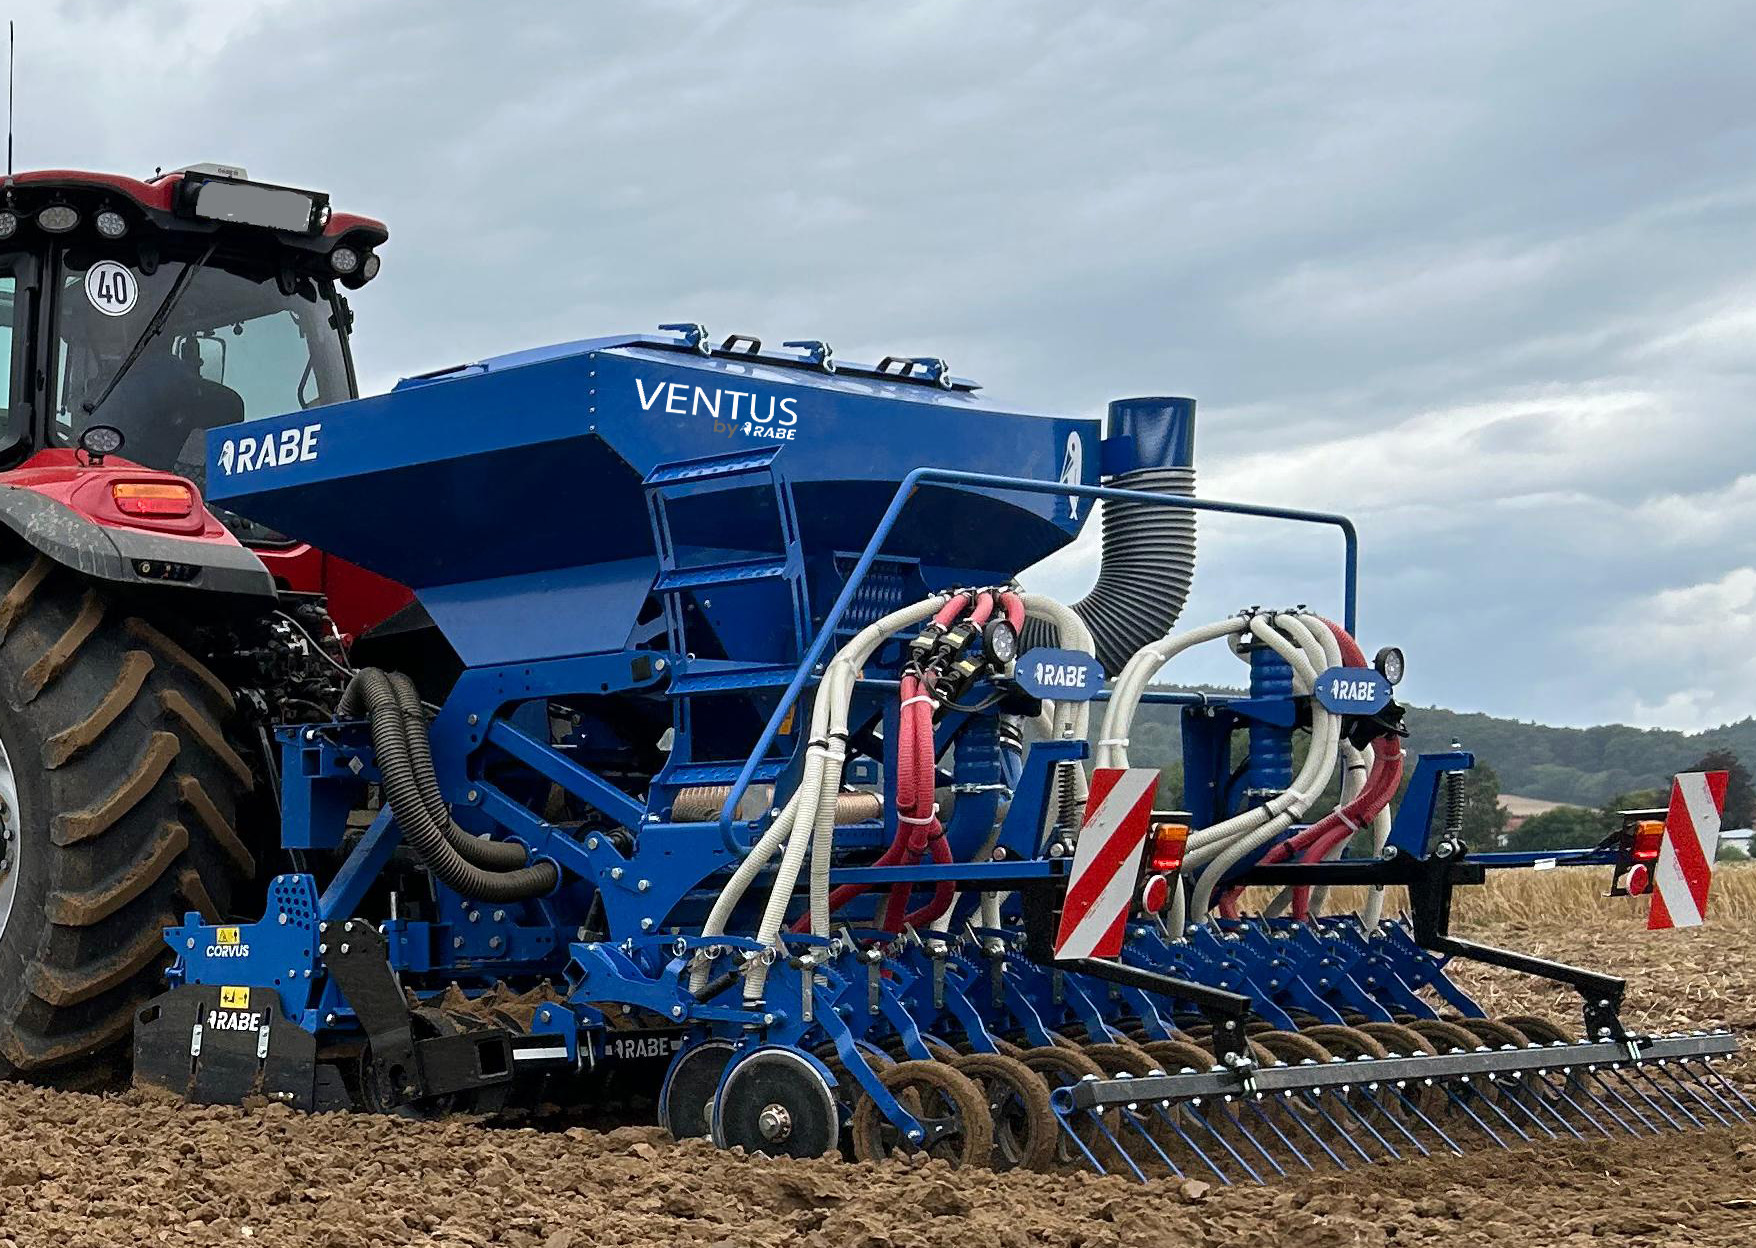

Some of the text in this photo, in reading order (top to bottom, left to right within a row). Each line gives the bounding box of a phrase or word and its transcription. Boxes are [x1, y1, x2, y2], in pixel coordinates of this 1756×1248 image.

[98, 270, 127, 305] 40
[635, 378, 798, 426] VENTUS
[713, 418, 797, 440] by RABE
[236, 424, 322, 473] RABE
[1045, 664, 1088, 687] RABE
[1339, 681, 1376, 701] RABE
[206, 944, 249, 958] CORVUS
[216, 1011, 260, 1031] RABE
[624, 1037, 669, 1058] RABE
